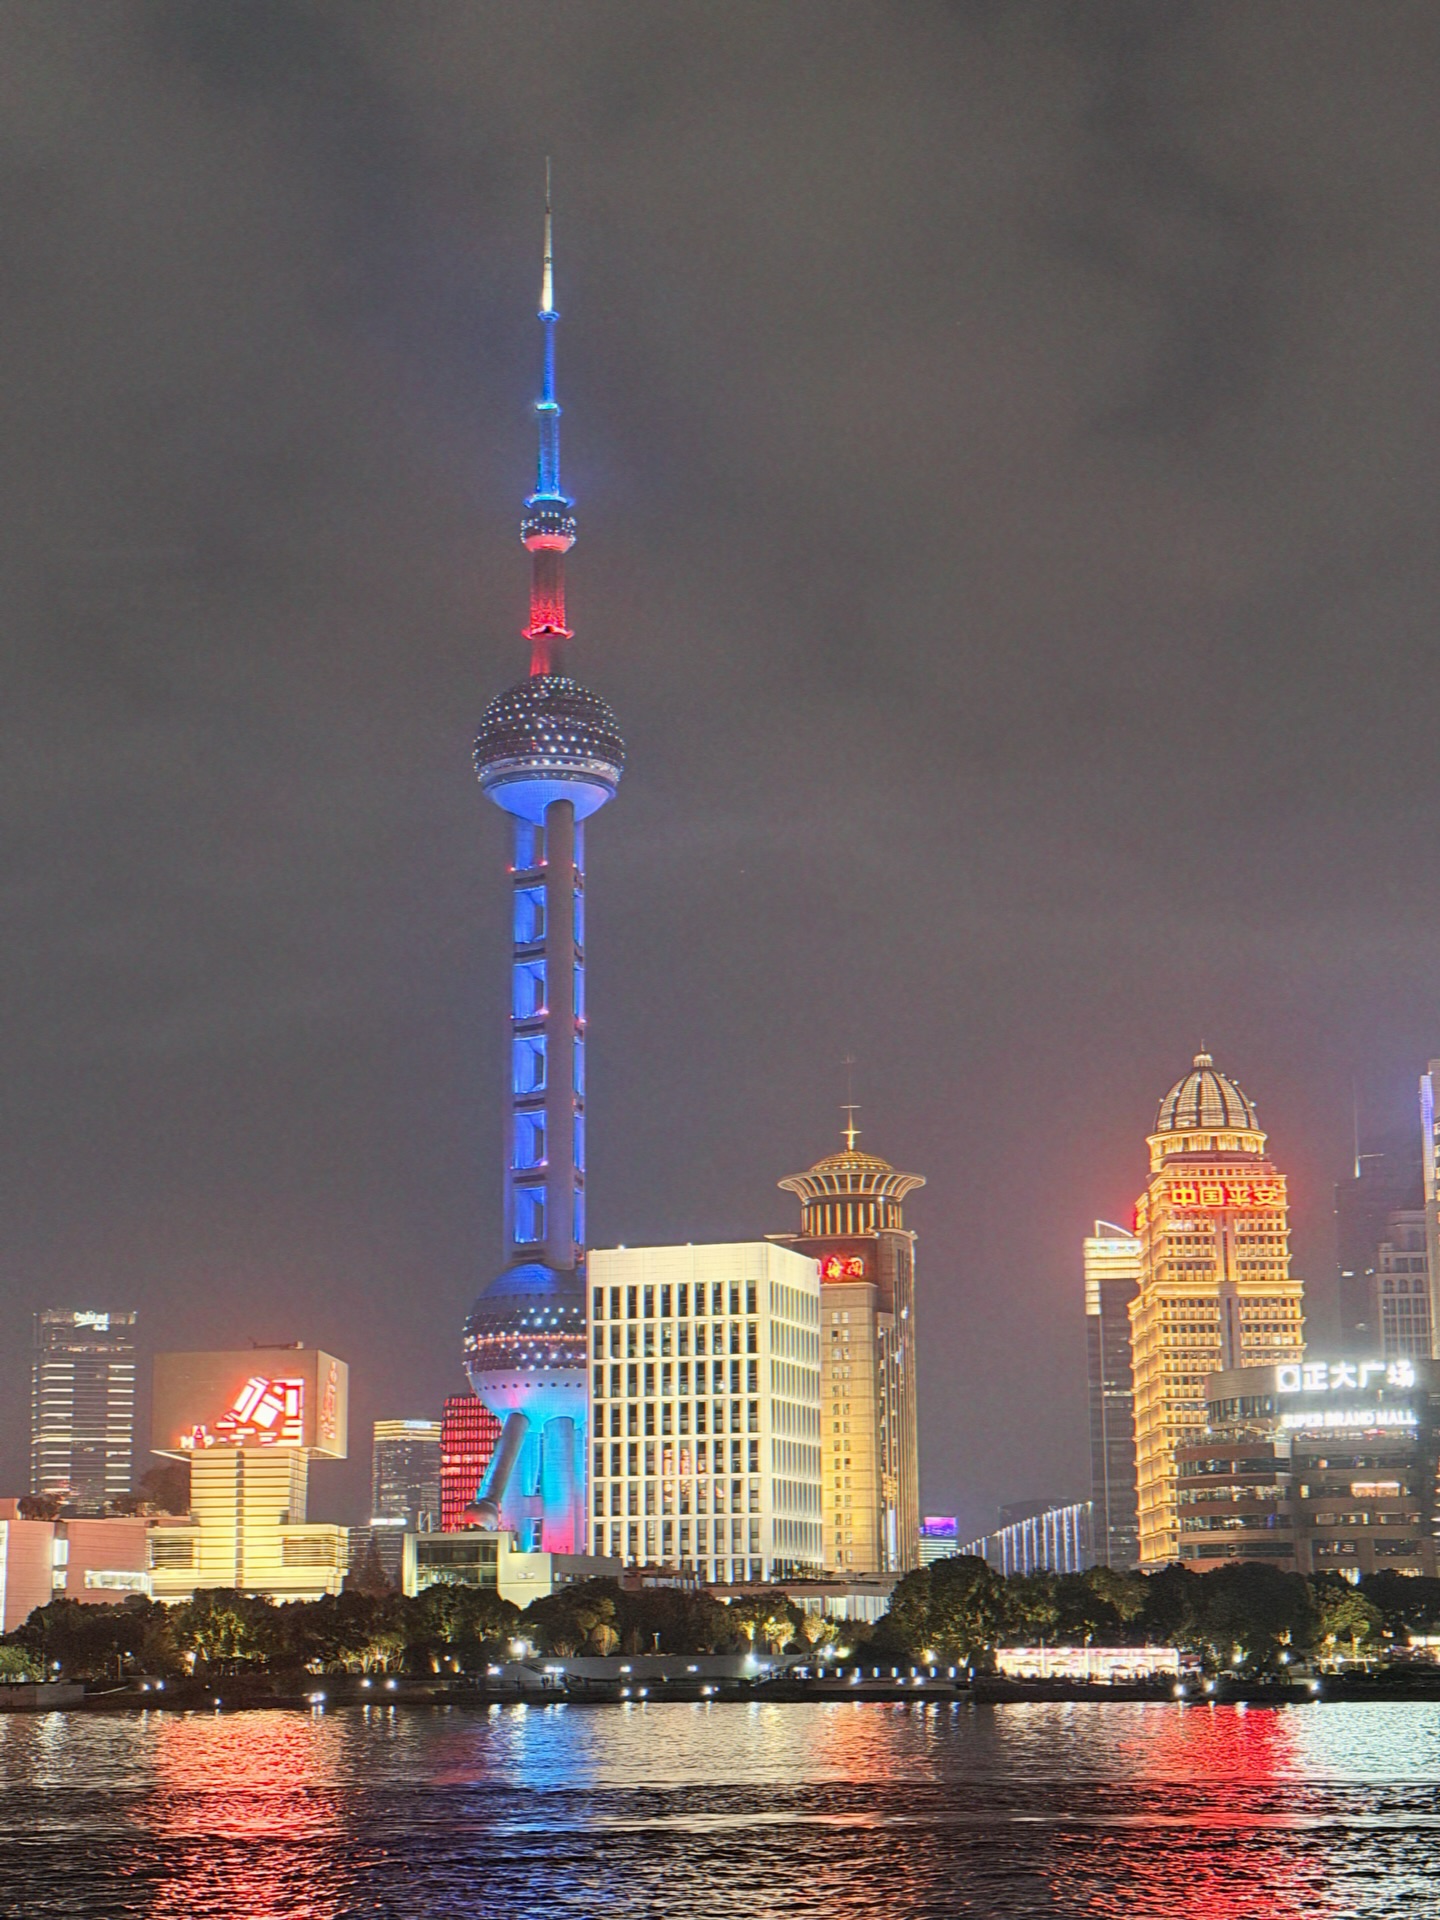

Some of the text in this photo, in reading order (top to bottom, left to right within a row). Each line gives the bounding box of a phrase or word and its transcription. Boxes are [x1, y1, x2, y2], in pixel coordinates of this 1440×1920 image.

[1171, 1187, 1278, 1206] 中国平安
[1302, 1360, 1415, 1391] 正大广场
[1281, 1409, 1419, 1428] SUPER BRAND MALL
